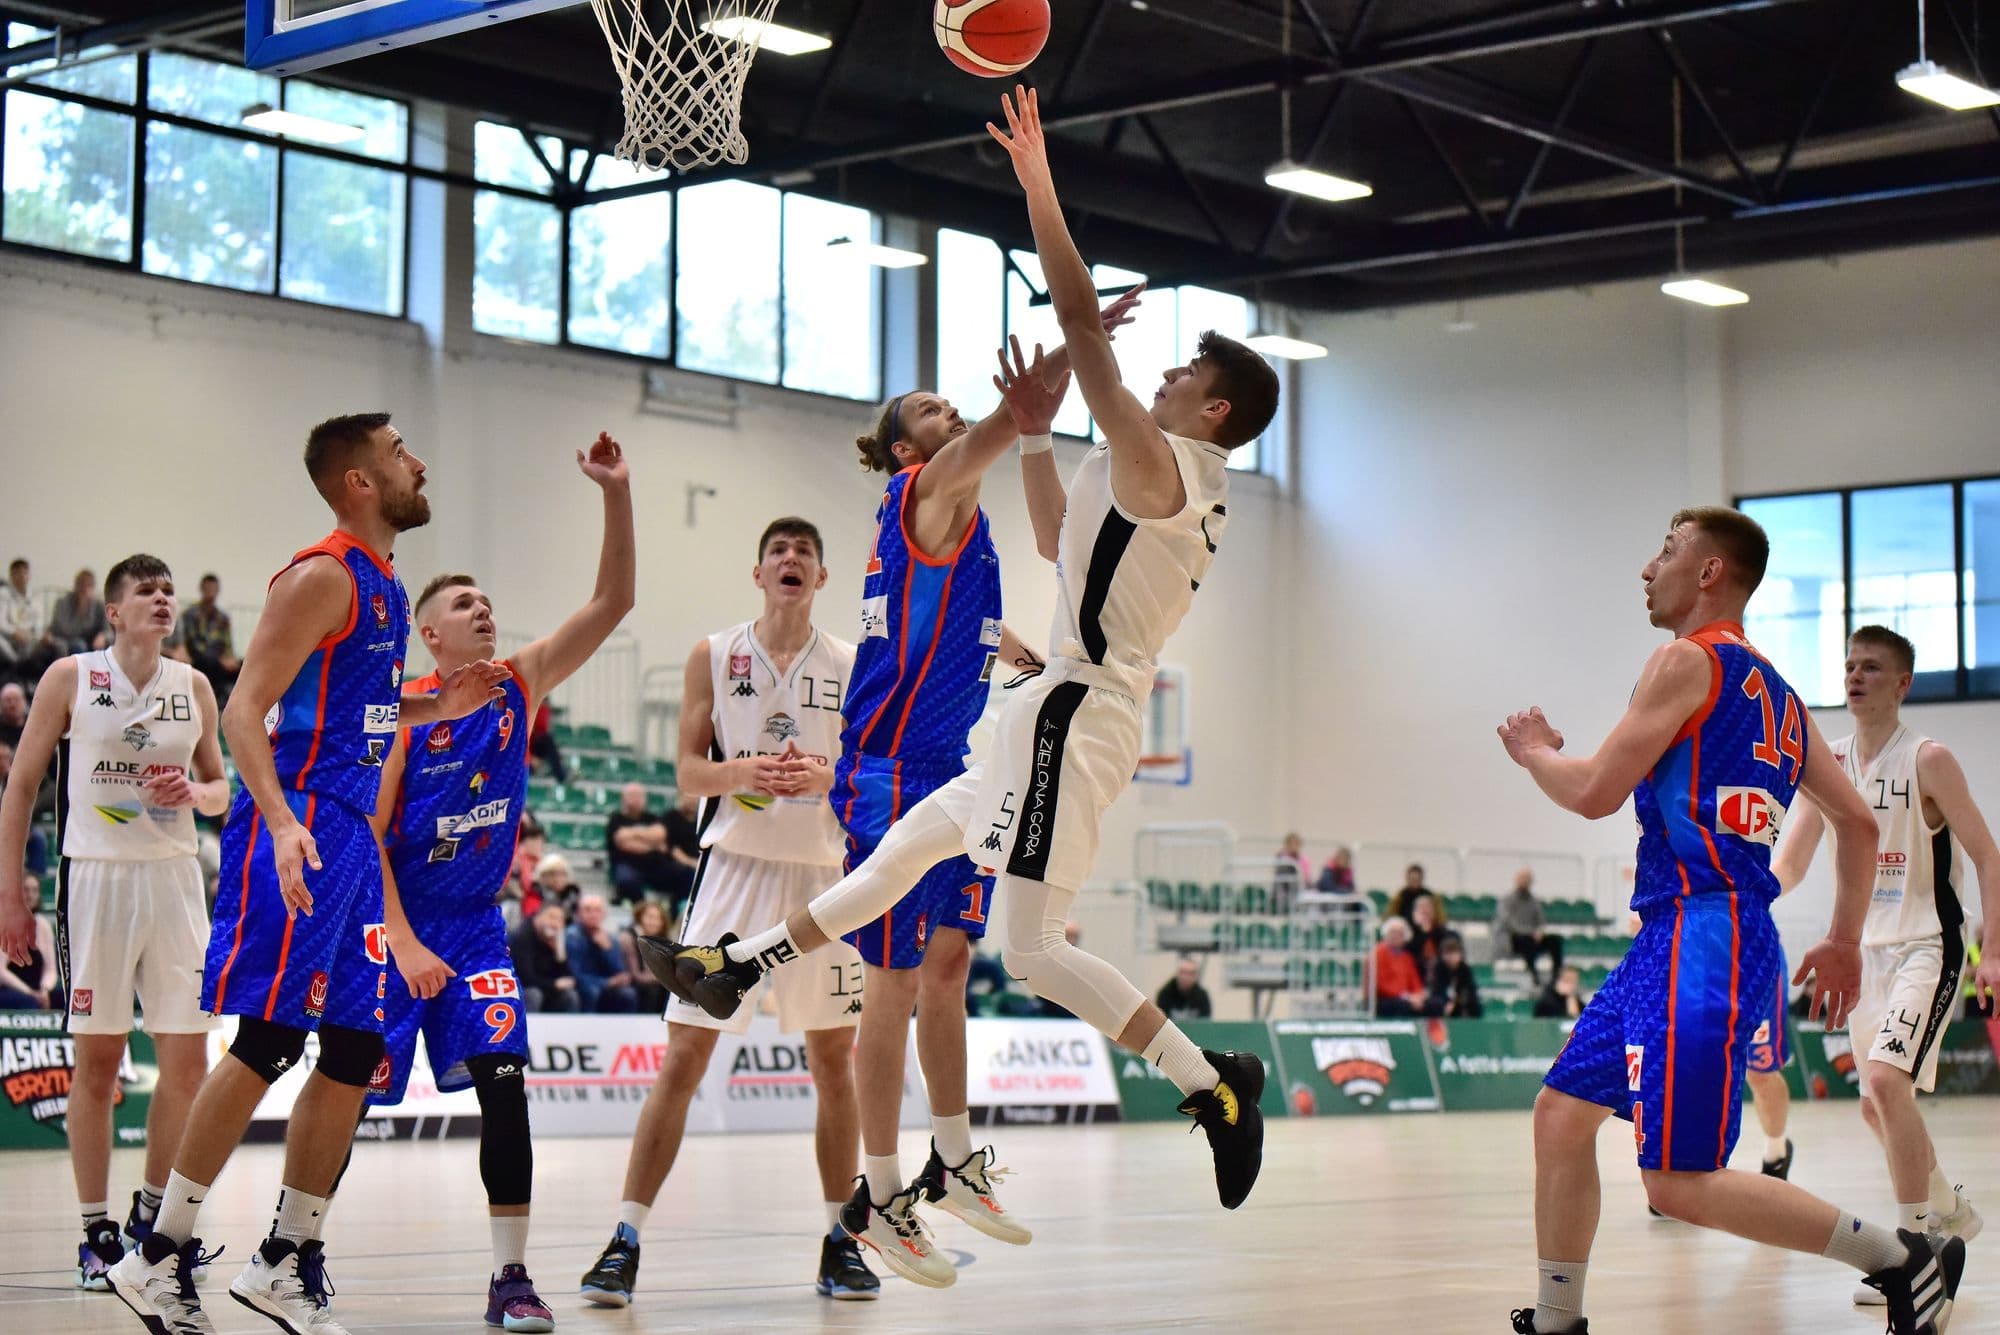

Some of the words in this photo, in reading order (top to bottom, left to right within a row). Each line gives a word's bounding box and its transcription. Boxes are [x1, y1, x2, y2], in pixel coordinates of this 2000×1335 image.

[154, 694, 191, 721] 18
[801, 676, 841, 712] 13
[498, 708, 515, 751] 9
[1741, 666, 1804, 786] 14
[93, 761, 140, 775] ALDE
[1033, 737, 1054, 809] ZIELONA
[992, 791, 1015, 830] 5
[1873, 779, 1910, 809] 14
[959, 882, 986, 924] 1
[830, 961, 863, 997] 13
[484, 1002, 517, 1044] 9
[1881, 1008, 1921, 1040] 14
